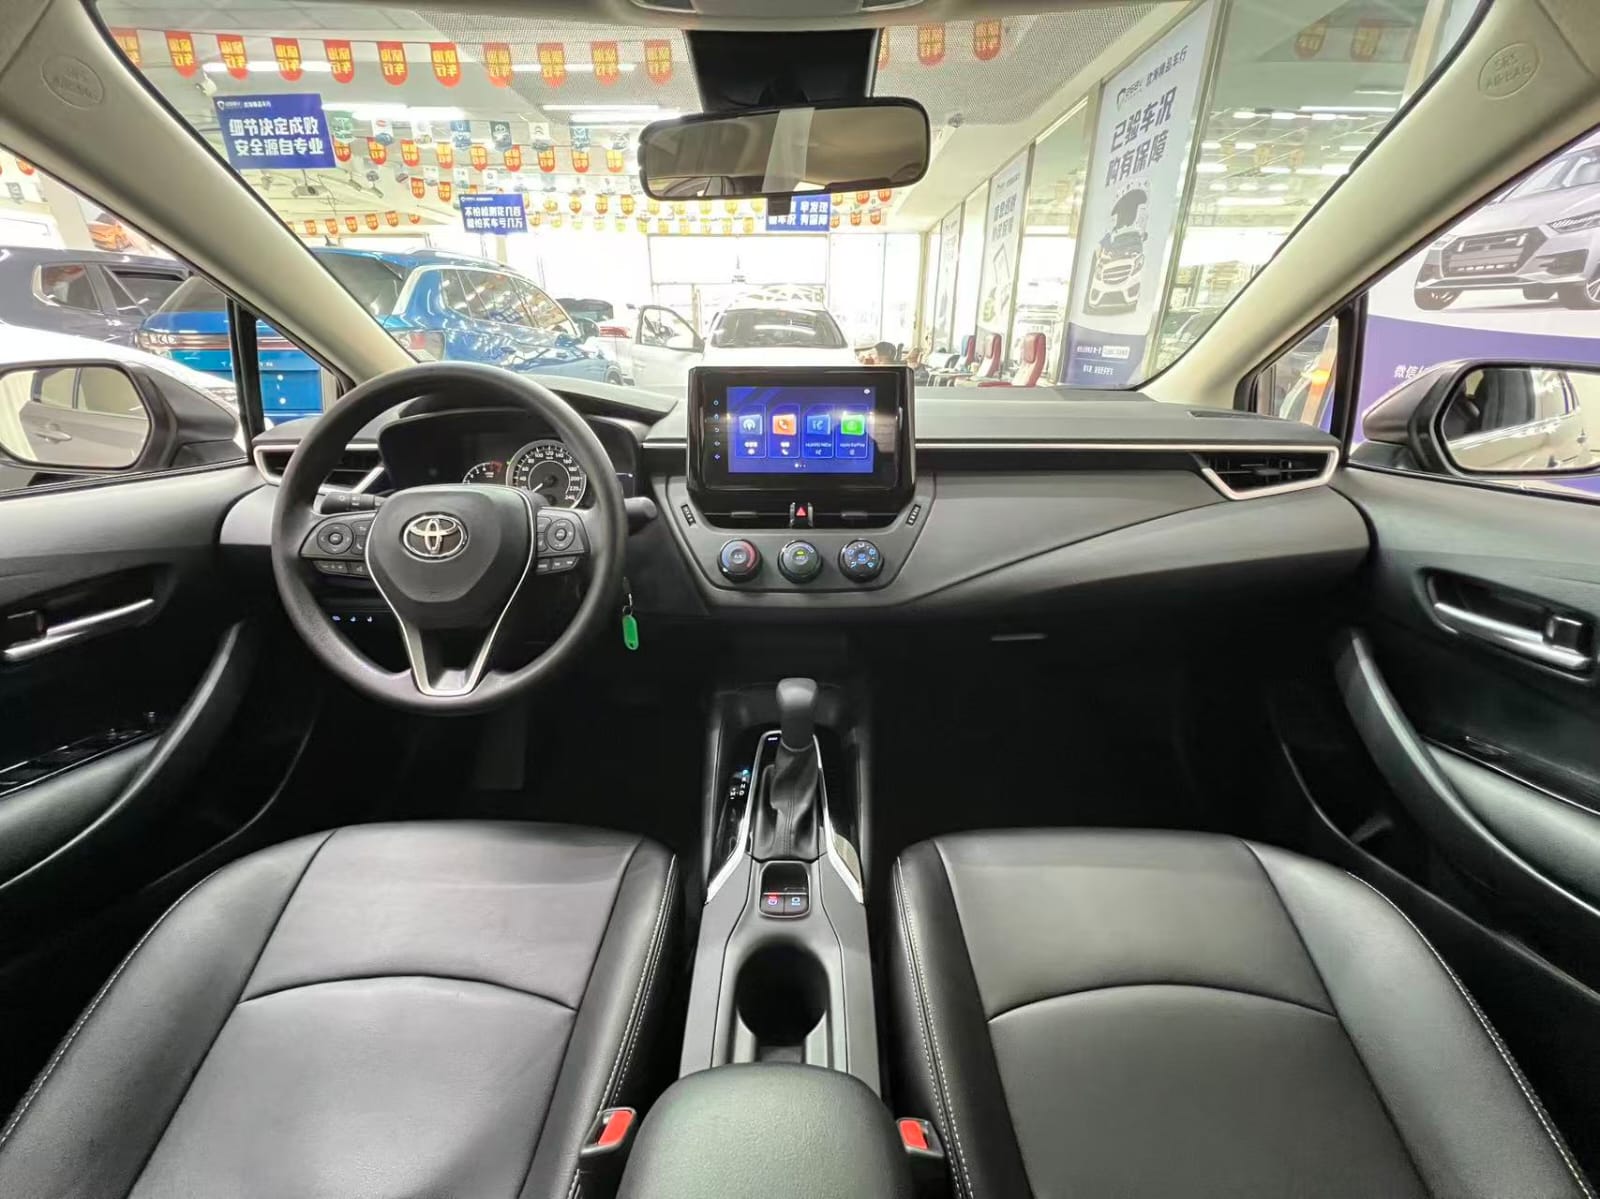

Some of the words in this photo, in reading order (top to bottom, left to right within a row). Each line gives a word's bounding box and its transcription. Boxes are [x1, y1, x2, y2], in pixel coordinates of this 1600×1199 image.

[228, 116, 320, 137] 细节决定成败
[1110, 86, 1177, 152] 已验车况
[234, 137, 325, 157] 安全源自专业
[1105, 129, 1168, 187] 购有保障
